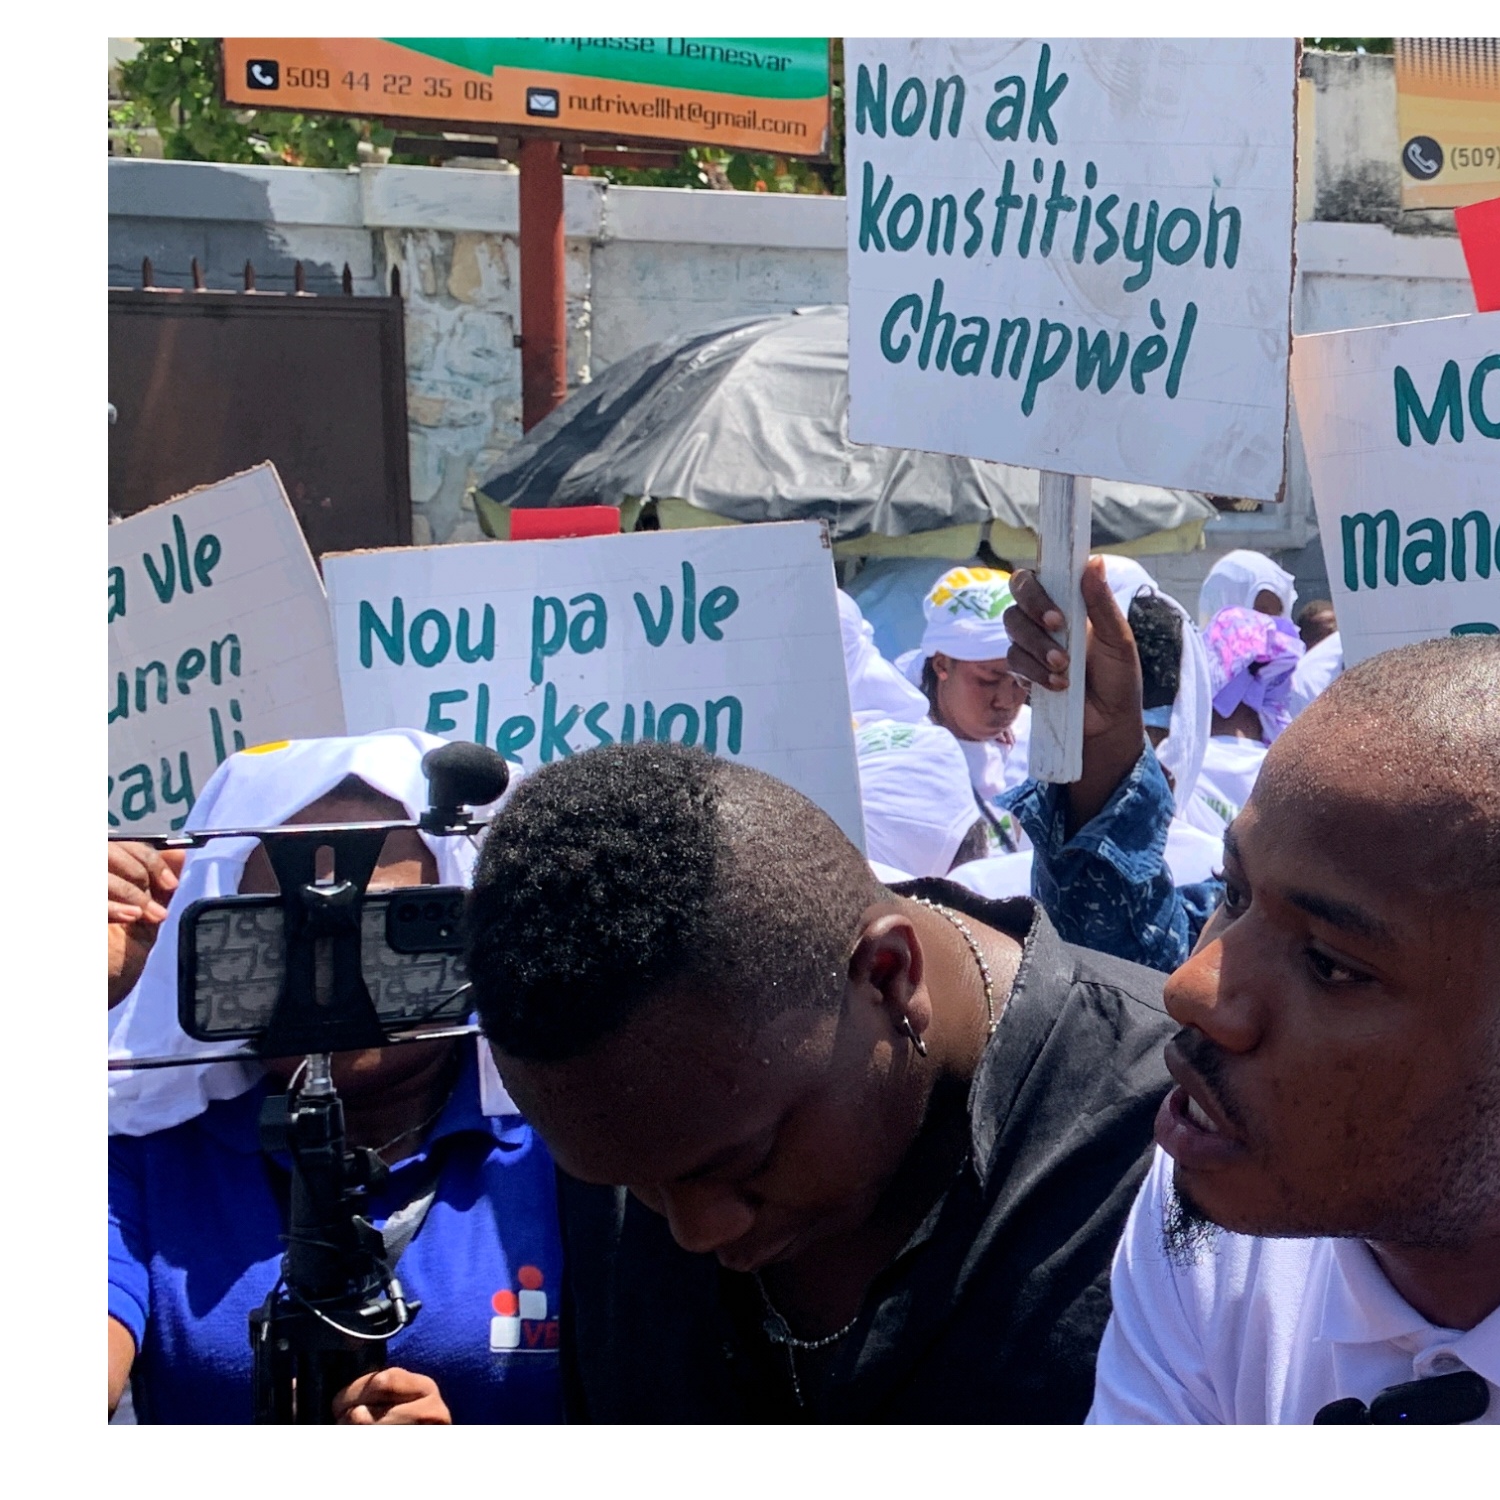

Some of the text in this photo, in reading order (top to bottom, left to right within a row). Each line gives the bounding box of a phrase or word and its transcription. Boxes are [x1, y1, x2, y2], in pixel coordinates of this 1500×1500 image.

[286, 67, 493, 101] 509 44 22 35 06
[568, 93, 807, 137] nutriwellht@gmail.com
[856, 43, 1068, 145] Non ak
[143, 514, 221, 604] vle
[359, 560, 740, 684] Nou pa vle
